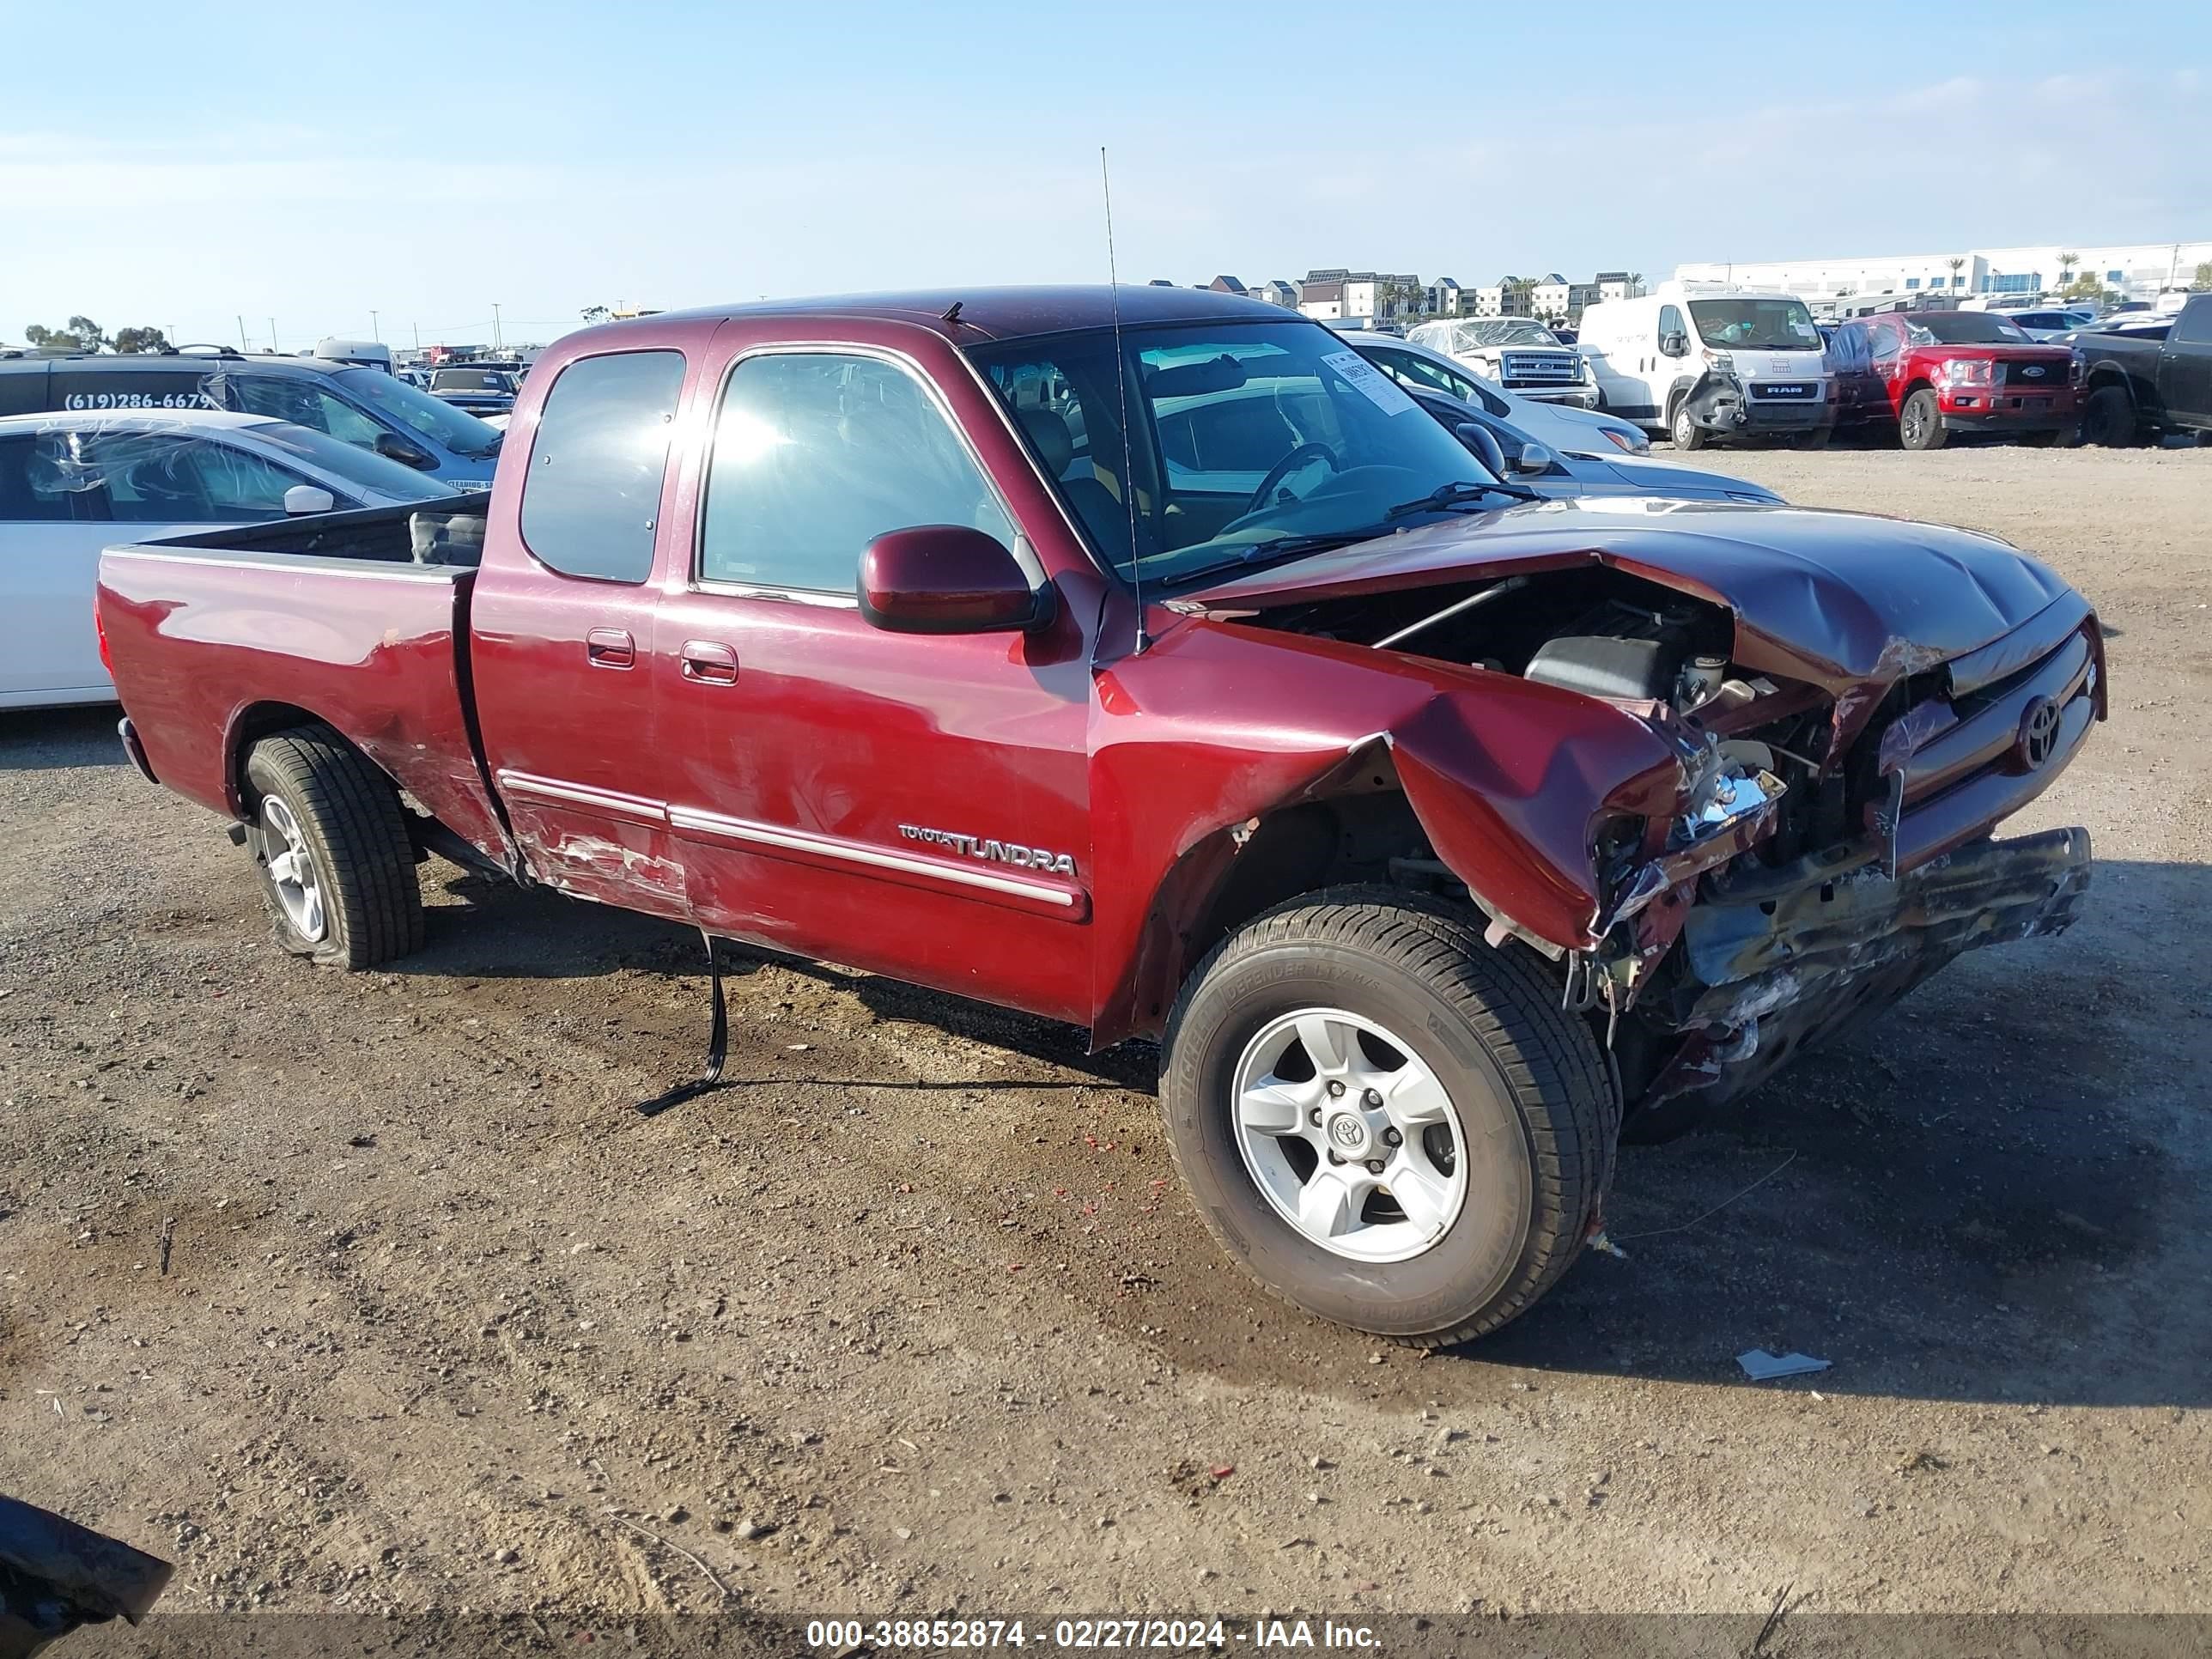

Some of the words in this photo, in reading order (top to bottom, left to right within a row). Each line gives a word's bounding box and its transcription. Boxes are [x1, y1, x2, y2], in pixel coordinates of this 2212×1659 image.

[64, 393, 210, 410] (619)286-6679
[898, 824, 953, 846] TOYOTA
[947, 833, 1078, 877] TUNDRA
[1227, 963, 1306, 998] DEFENDER
[1315, 963, 1348, 981] LTX
[1352, 972, 1382, 990] M/S
